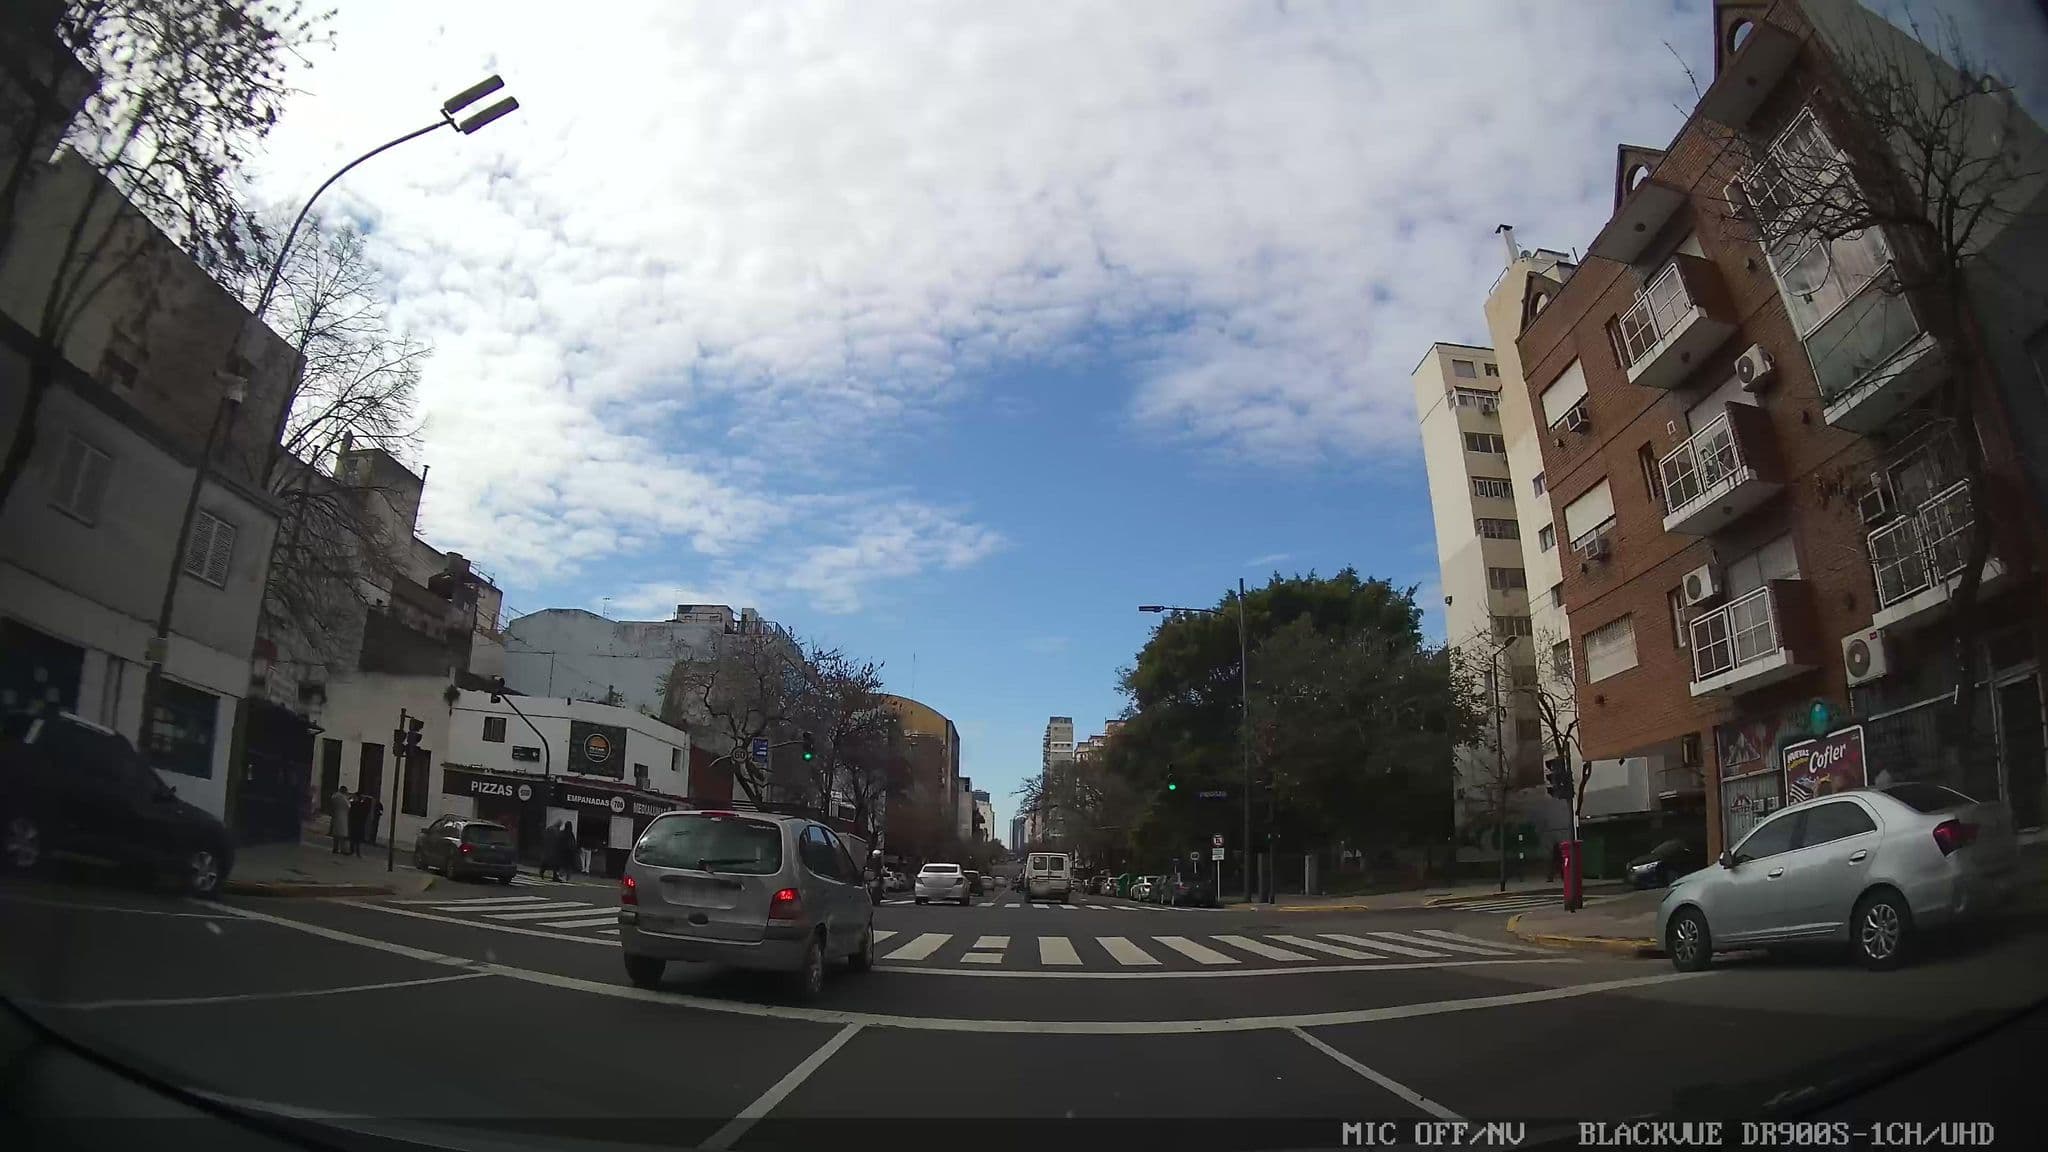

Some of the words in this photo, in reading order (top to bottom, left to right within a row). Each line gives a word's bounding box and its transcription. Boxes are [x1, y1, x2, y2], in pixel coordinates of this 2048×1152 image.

[1809, 744, 1846, 773] Cofler
[471, 781, 513, 796] PIZZAS
[567, 794, 609, 807] EMPANADAS
